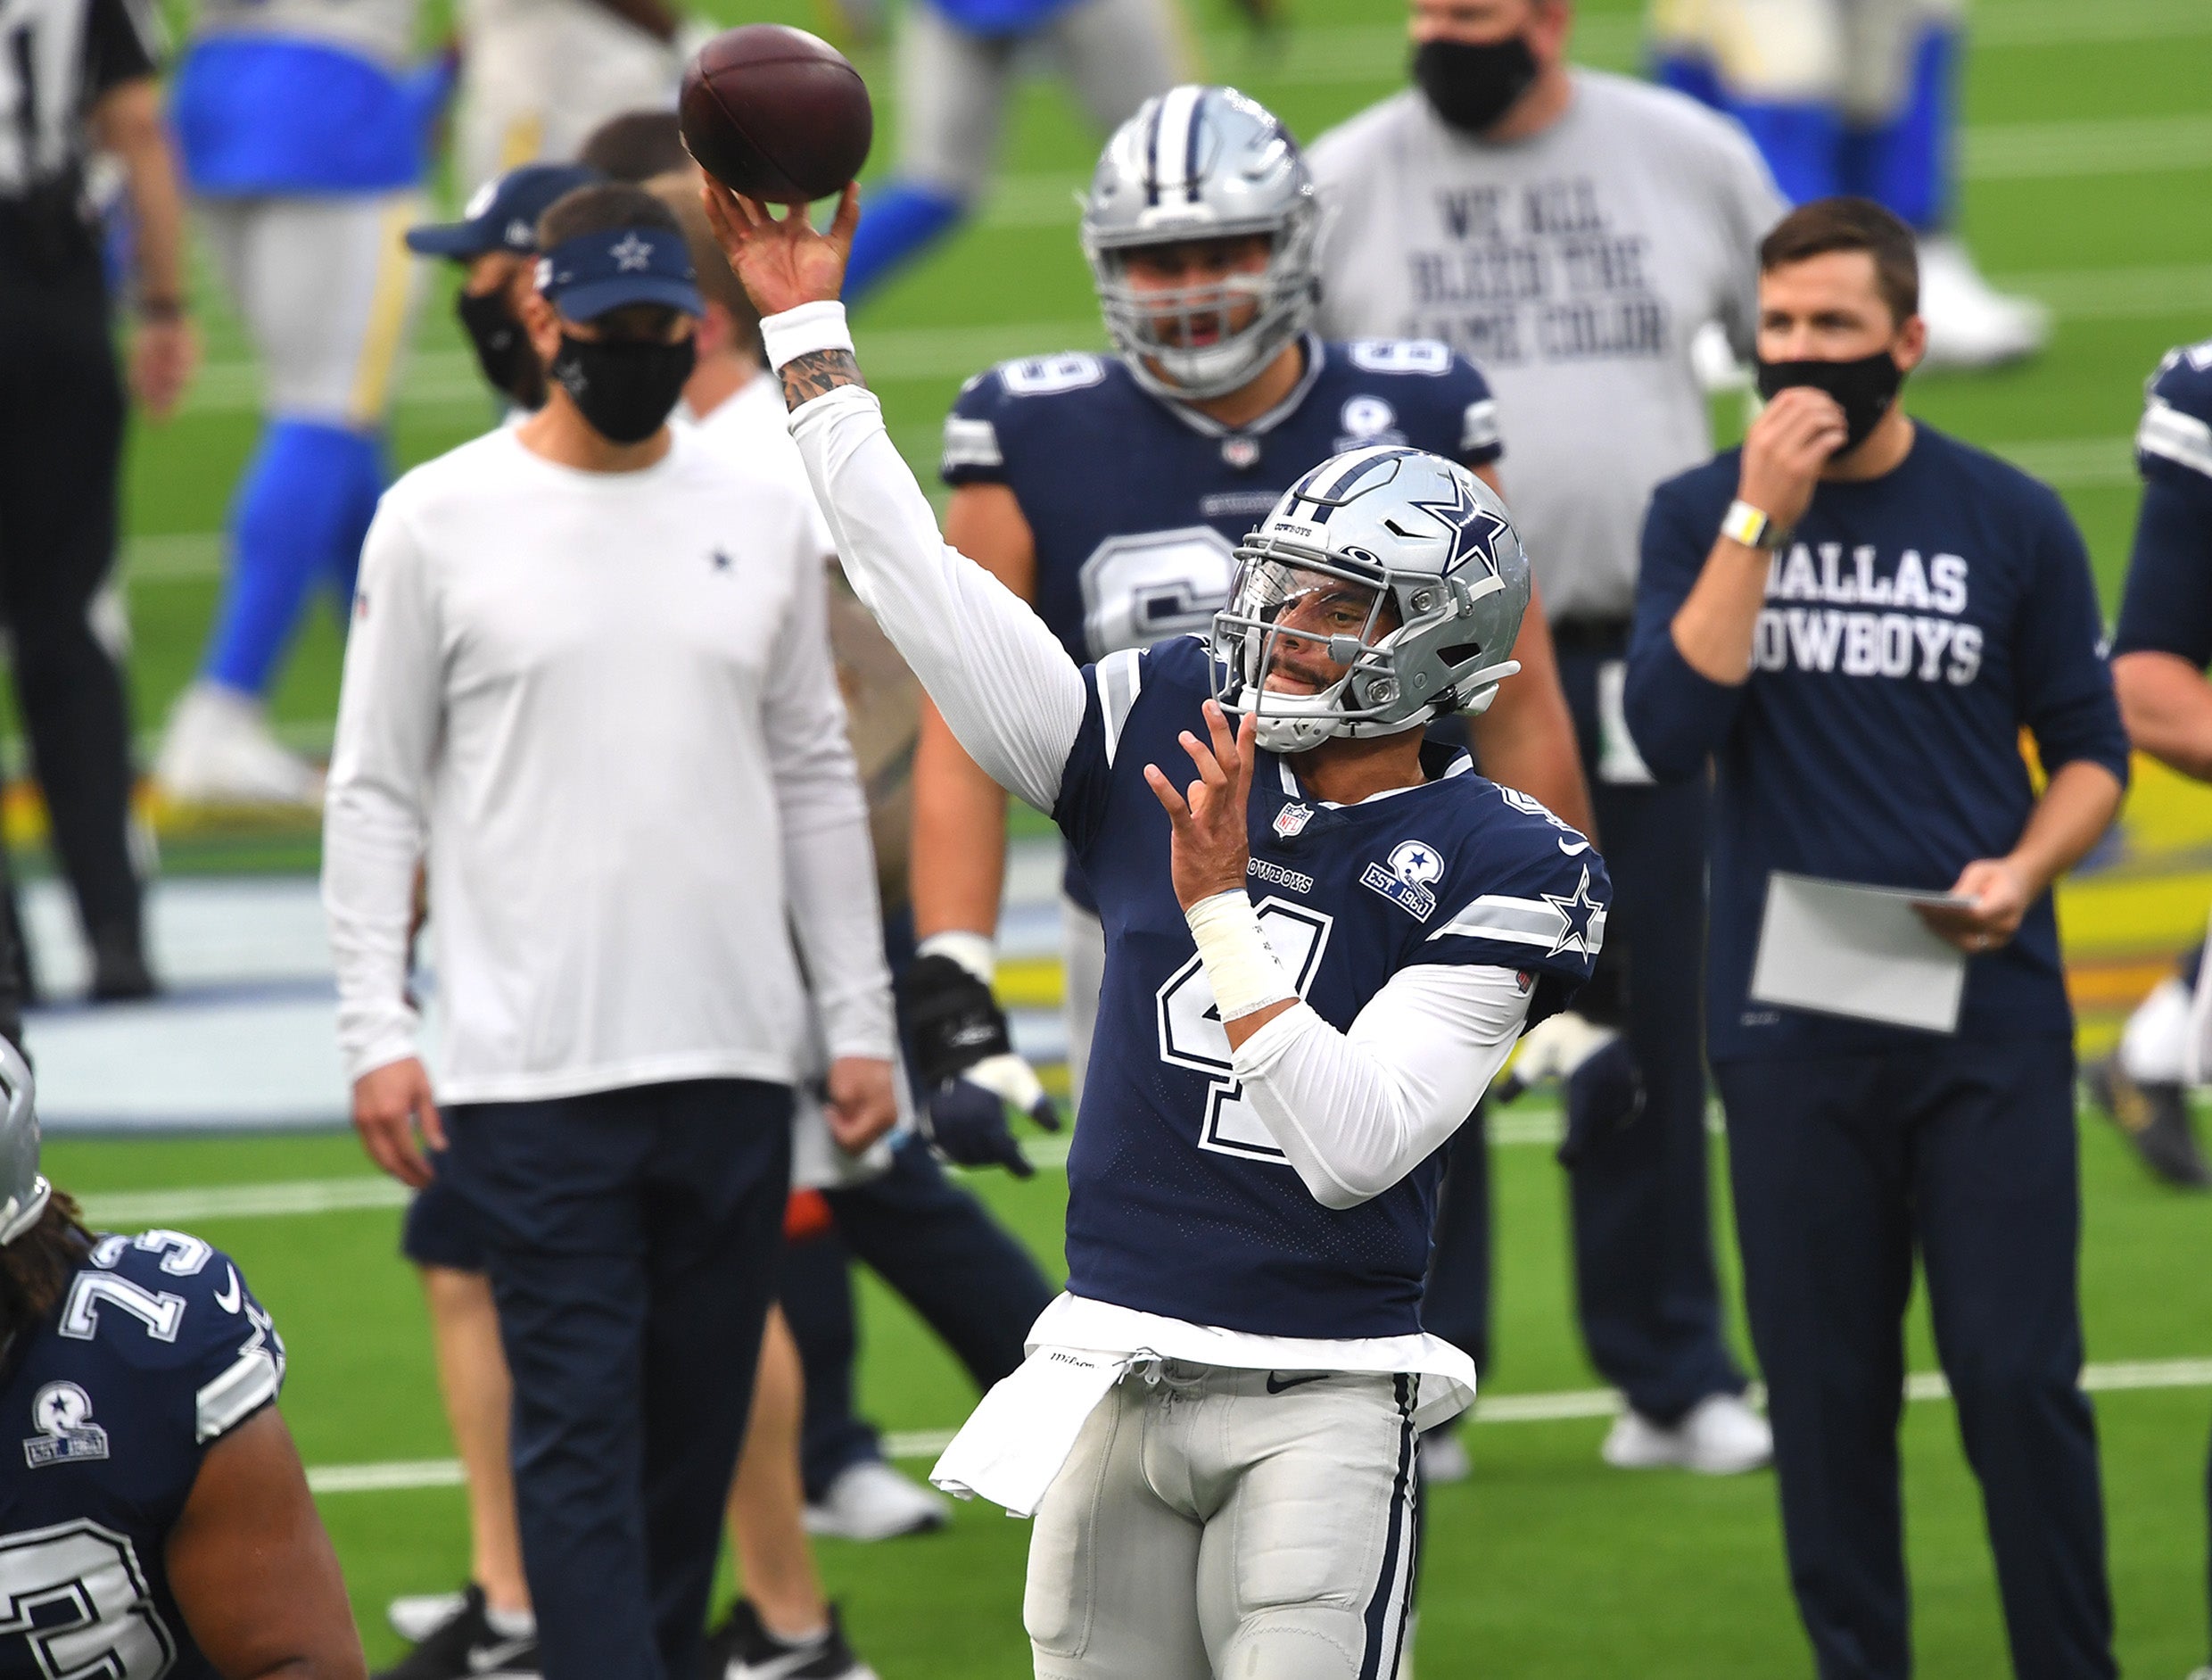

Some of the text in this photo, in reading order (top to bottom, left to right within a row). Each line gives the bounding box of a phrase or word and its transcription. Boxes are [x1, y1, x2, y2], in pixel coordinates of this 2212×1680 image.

[1746, 607, 1984, 686] OWBOYS
[1279, 814, 1298, 832] NFL
[1247, 857, 1314, 894] OWBOYS
[1366, 867, 1430, 916] EST. 1960
[1156, 895, 1334, 1167] 4
